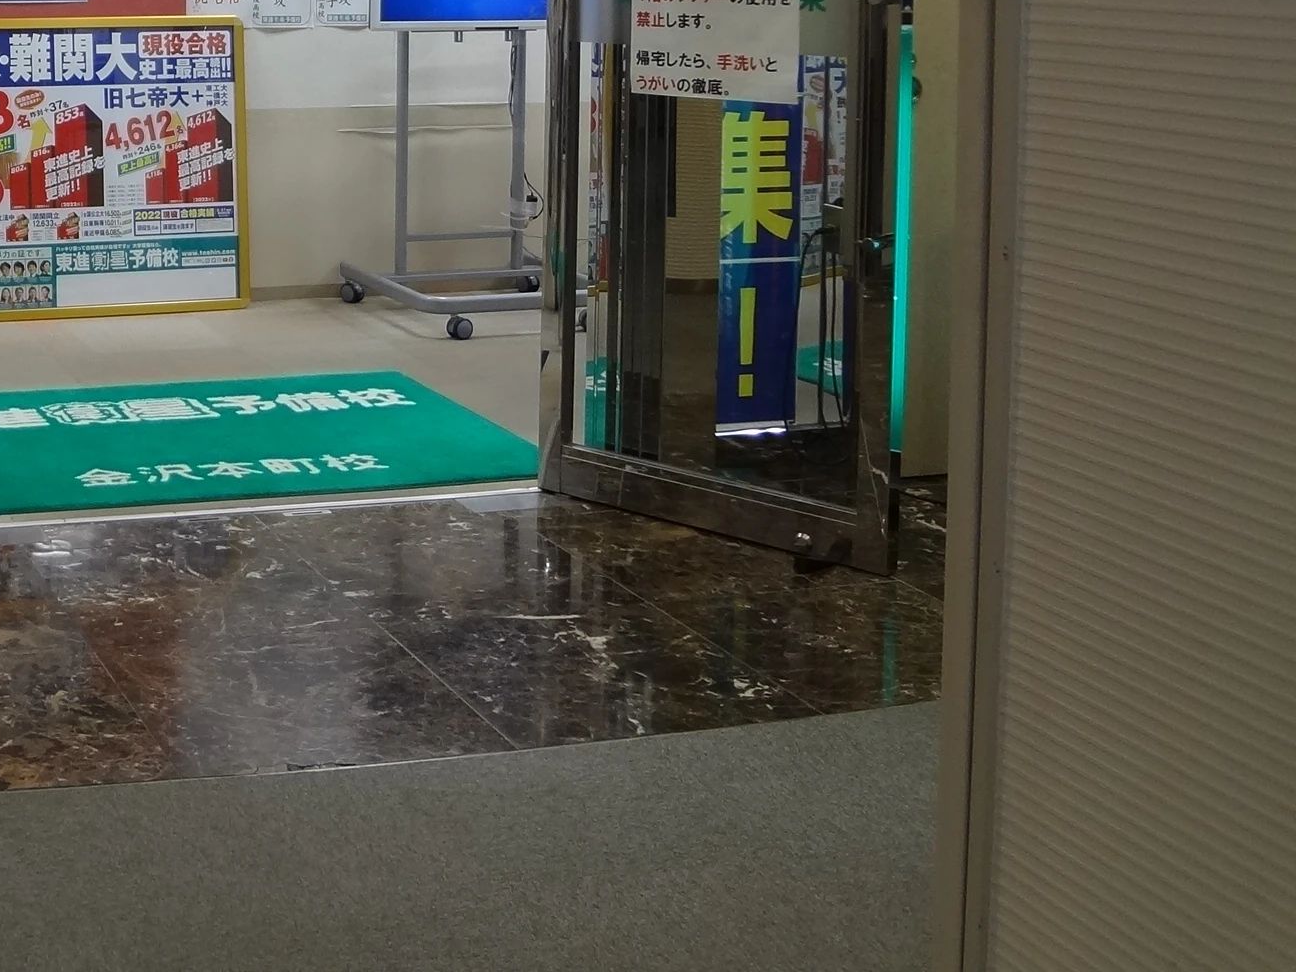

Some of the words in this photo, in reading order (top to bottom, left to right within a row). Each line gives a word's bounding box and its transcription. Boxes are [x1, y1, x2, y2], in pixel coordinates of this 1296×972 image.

[637, 11, 712, 30] 禁止します。
[142, 32, 228, 56] 現役合格
[636, 49, 778, 72] 帰宅したら、手洗いと
[637, 75, 730, 96] うがいの徹底。
[44, 145, 94, 173] 東進史上
[135, 211, 161, 220] 2022
[56, 247, 179, 272] 東進衛星予備校
[75, 453, 389, 487] 金沢本町校
